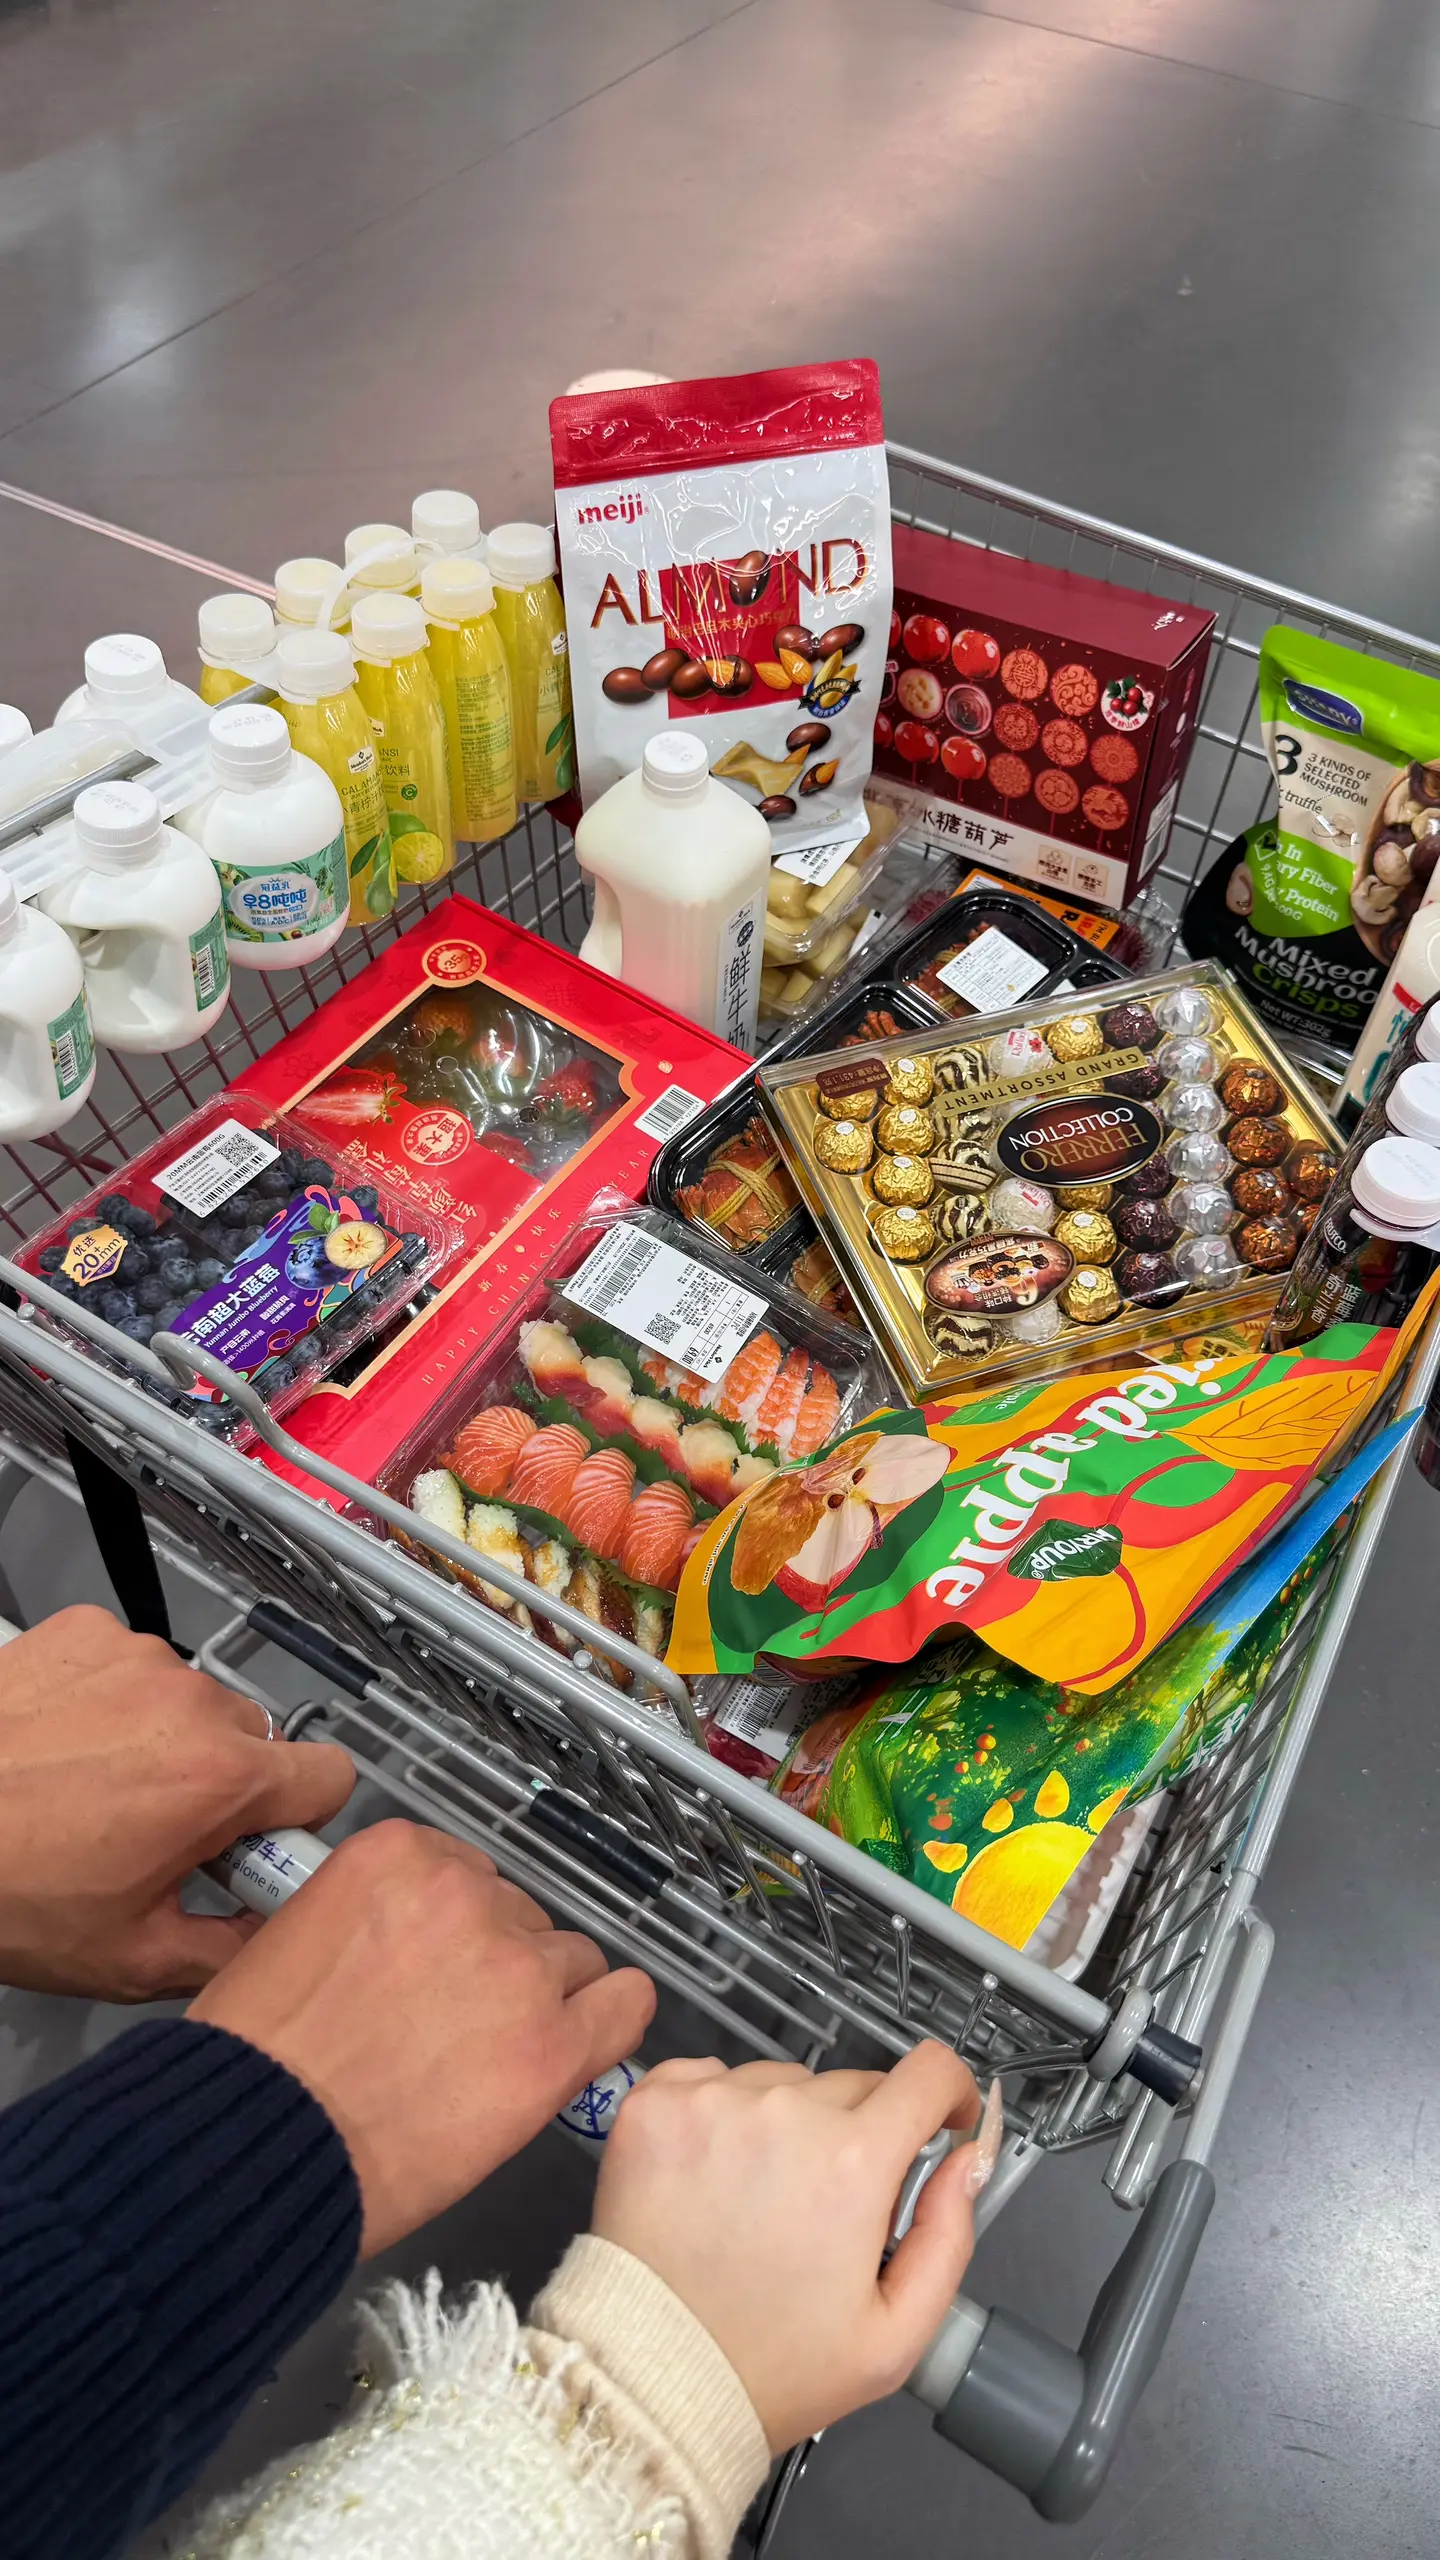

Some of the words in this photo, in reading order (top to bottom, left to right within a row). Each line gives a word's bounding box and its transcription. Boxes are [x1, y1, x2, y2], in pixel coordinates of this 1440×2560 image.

[578, 493, 645, 526] meiji
[1275, 734, 1302, 775] 3
[1308, 753, 1317, 762] 3
[1319, 756, 1354, 776] KINDS
[1357, 769, 1372, 781] OF
[1299, 773, 1368, 807] MUSHROOM
[1304, 763, 1360, 790] SELECTED
[1285, 787, 1323, 814] truffle
[242, 888, 307, 909] 早8吨吨
[1299, 867, 1337, 895] Fiber
[1284, 886, 1341, 923] Protein
[1234, 925, 1378, 1004] Mushroo
[1268, 937, 1378, 986] Mixed
[1252, 962, 1360, 1018] Crisps
[1260, 999, 1279, 1015] Net
[1077, 1053, 1140, 1077] GRAND
[944, 1071, 1069, 1112] ASSORTMENT
[412, 1115, 457, 1160] 超大果
[1008, 1105, 1134, 1150] COLLECTION
[1019, 1124, 1151, 1174] FERRERO
[343, 1136, 479, 1227] 红颜草莓礼盒
[71, 1233, 97, 1258] 优选
[476, 1258, 510, 1294] 新春
[529, 1205, 562, 1238] 快乐
[969, 1232, 995, 1245] NEW
[421, 1326, 479, 1386] HAPPY
[609, 1148, 650, 1189] YEAR
[178, 1258, 282, 1349] 云南超大蓝莓
[203, 1325, 229, 1349] Yunnan
[226, 1308, 250, 1330] Jumbo
[246, 1283, 279, 1313] Blueberry
[983, 1292, 1012, 1308] 种口味
[681, 1345, 699, 1365] 69.00
[924, 1432, 1099, 1607] apple
[231, 1855, 269, 1888] alone
[265, 1880, 283, 1898] in
